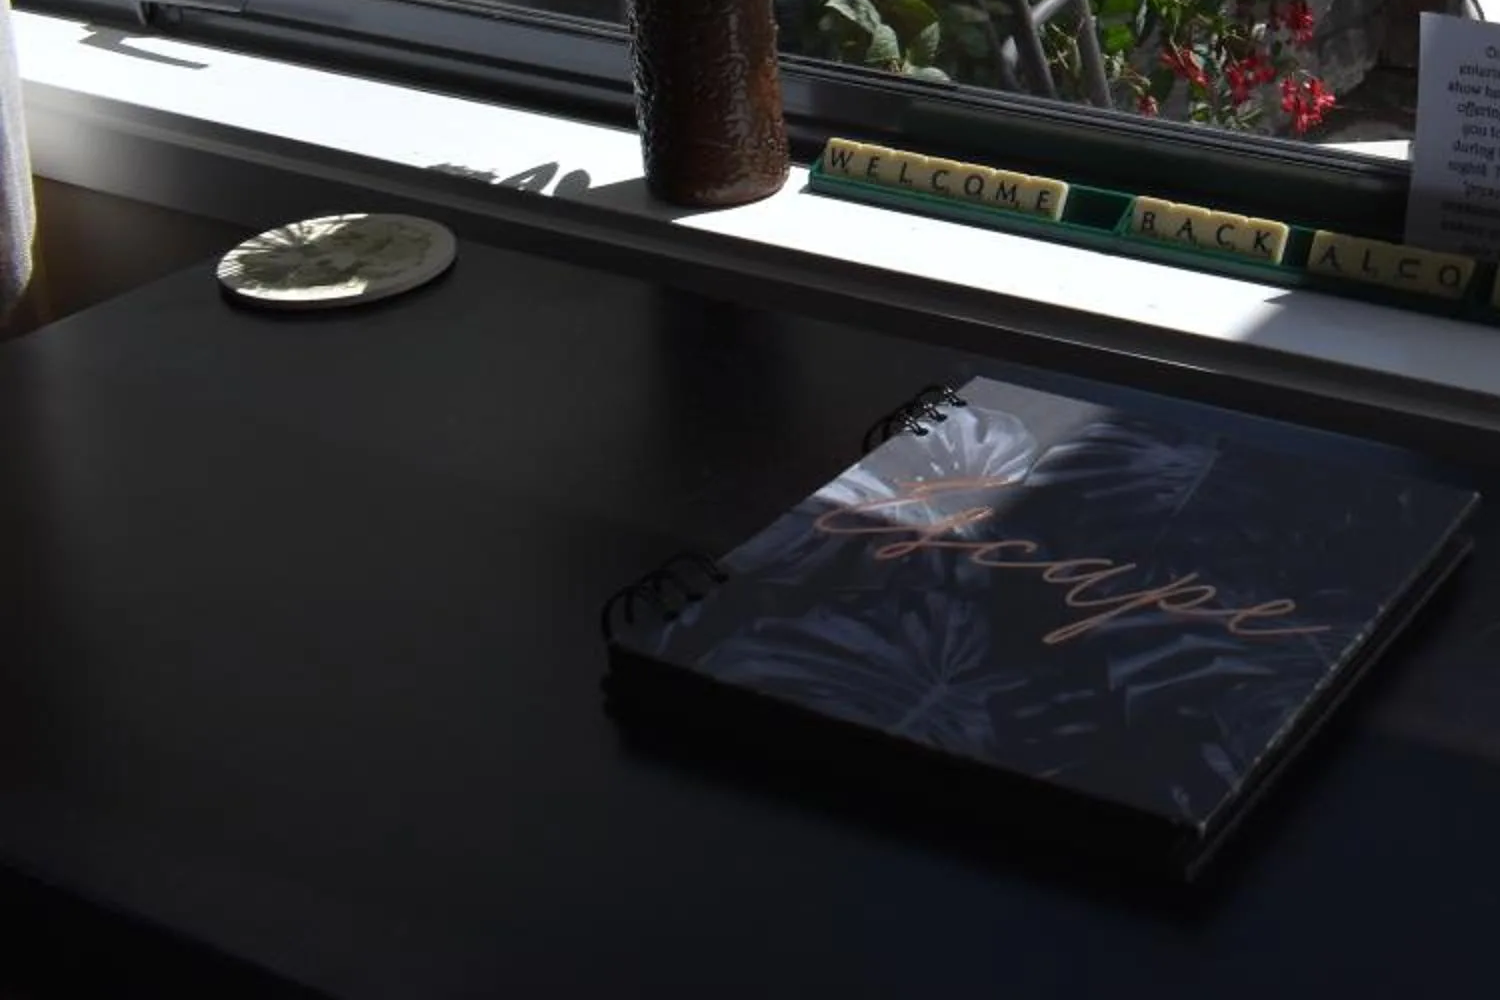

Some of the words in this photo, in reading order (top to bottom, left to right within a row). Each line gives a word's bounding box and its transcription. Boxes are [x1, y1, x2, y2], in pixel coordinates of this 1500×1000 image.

[829, 146, 1051, 211] WELCOME
[1142, 210, 1273, 257] BACK
[1318, 245, 1462, 288] ALCO
